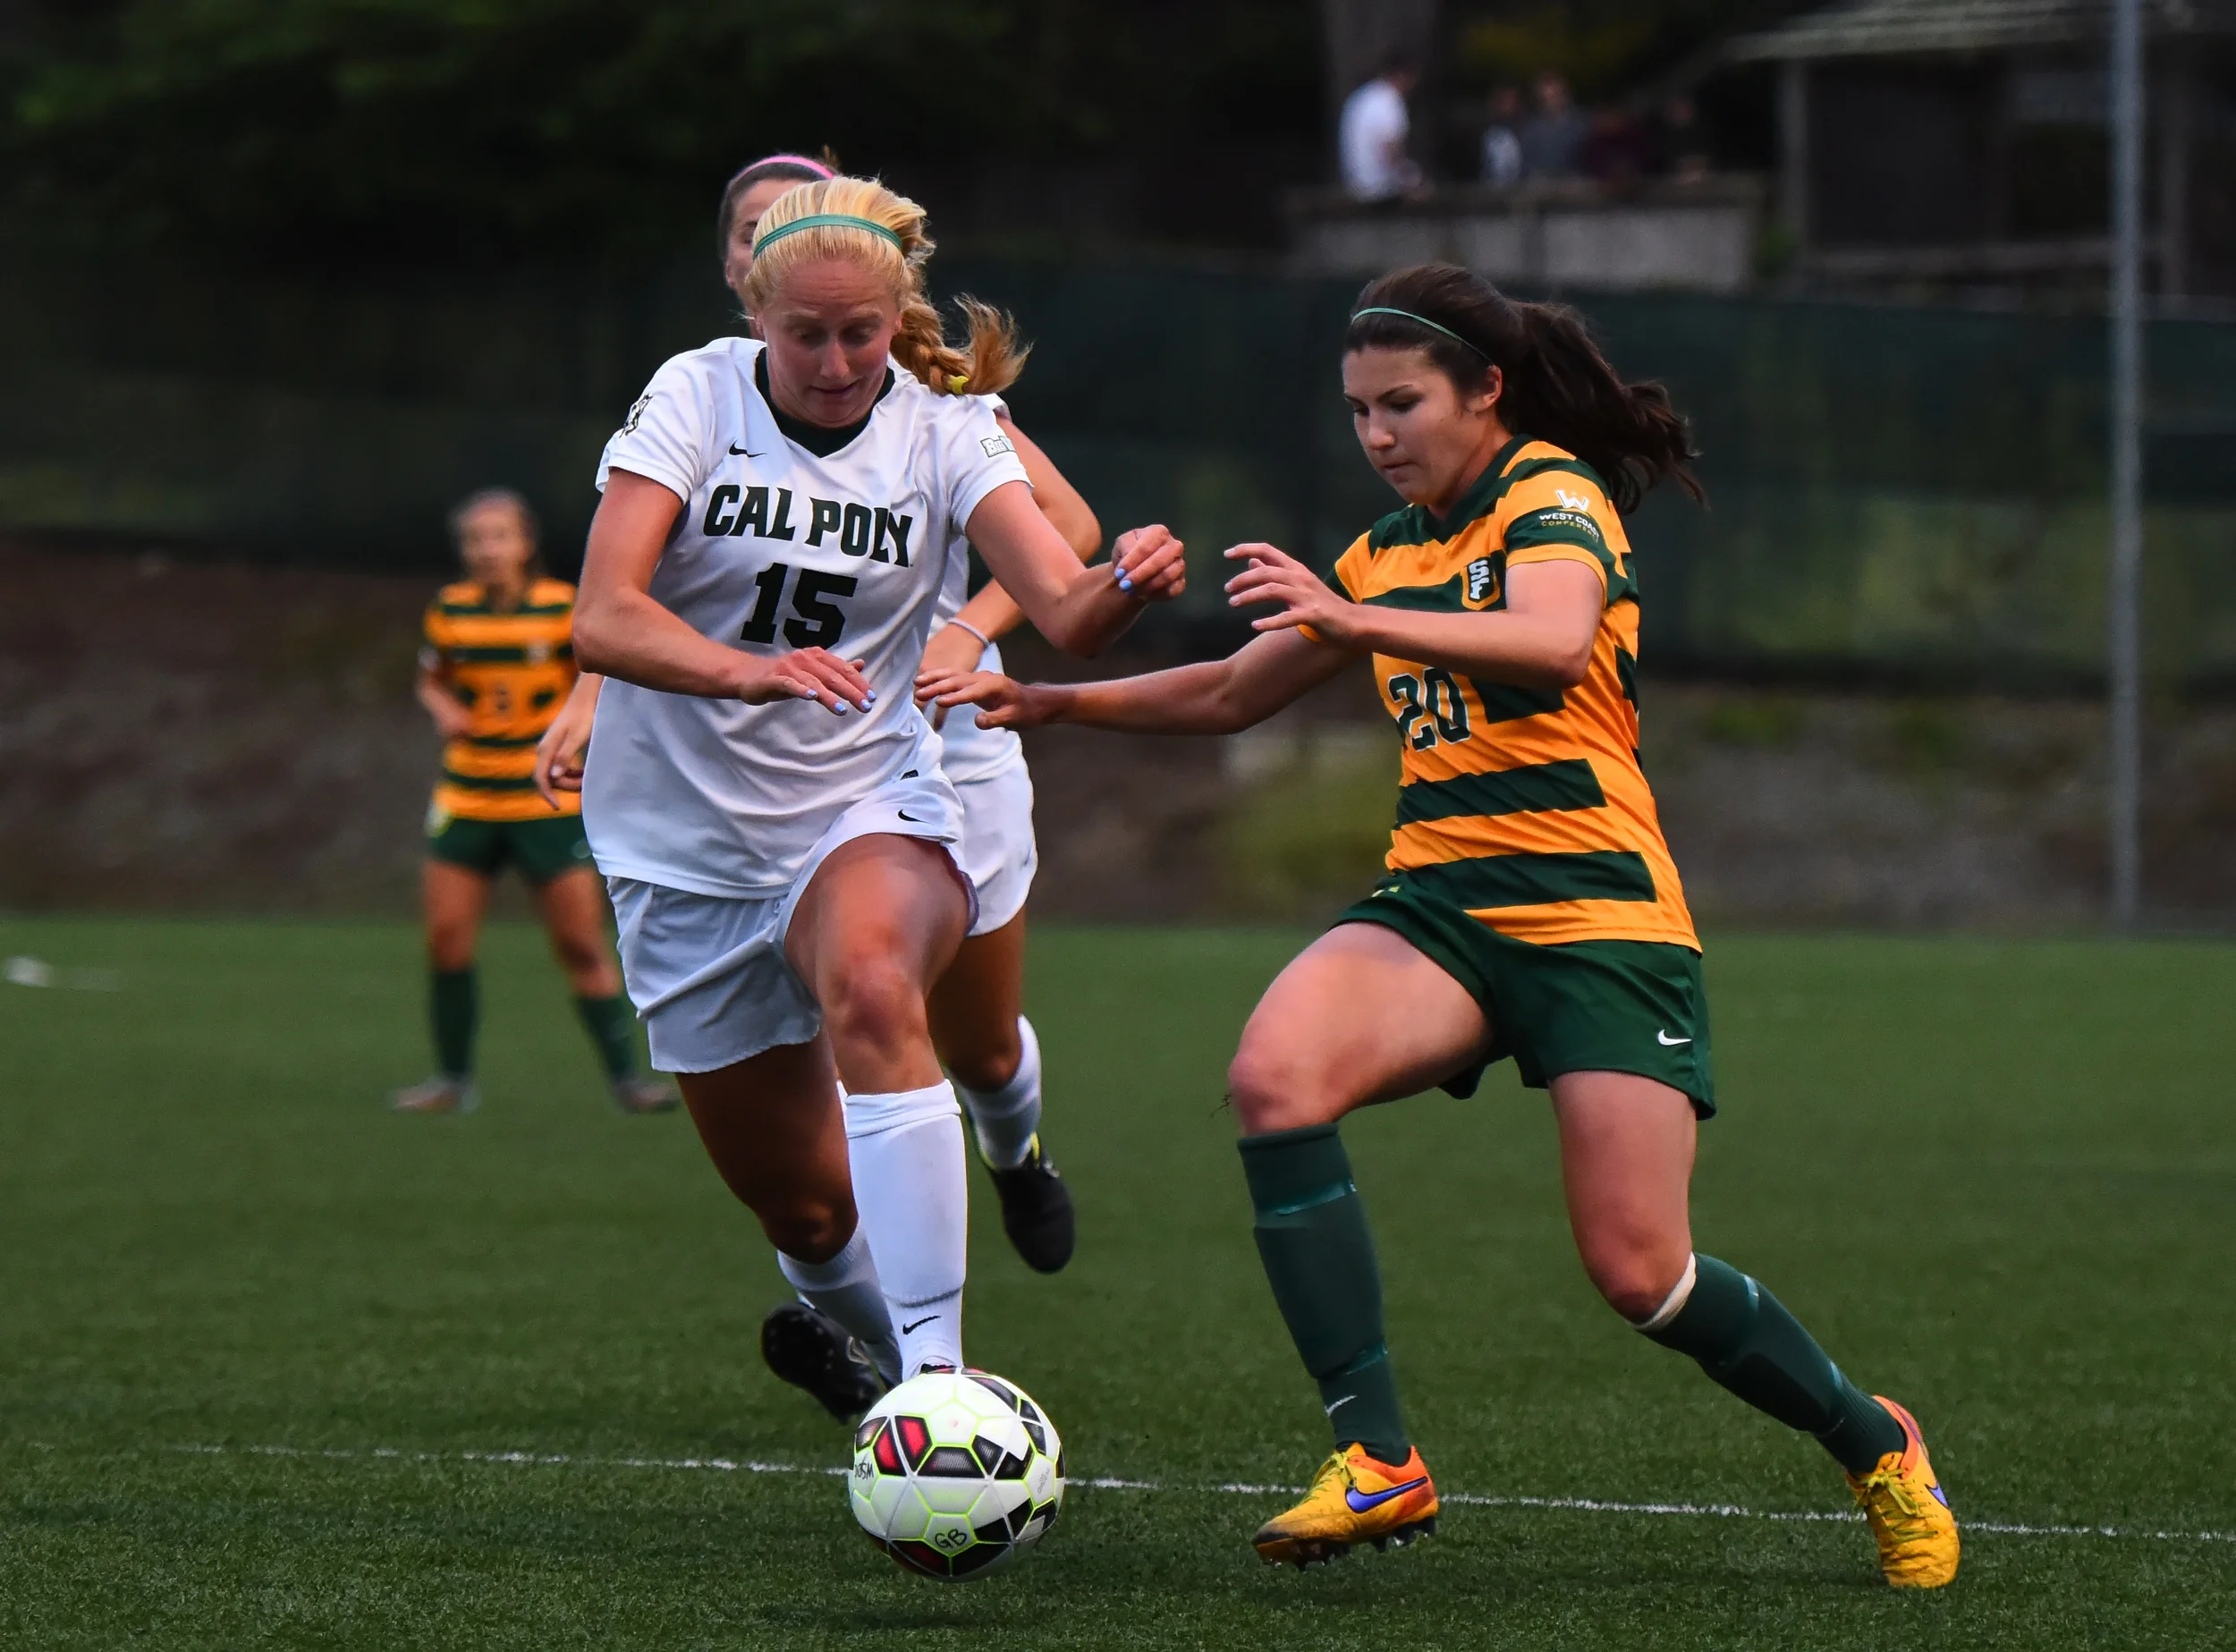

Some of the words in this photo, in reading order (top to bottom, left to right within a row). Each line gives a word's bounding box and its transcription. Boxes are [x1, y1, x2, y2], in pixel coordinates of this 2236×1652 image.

[703, 485, 795, 541] CAL
[805, 497, 913, 567] POLY
[1539, 513, 1574, 521] WEST
[741, 563, 859, 650] 15
[1469, 560, 1490, 599] SF
[1387, 666, 1471, 752] 20
[935, 1529, 968, 1548] GB
